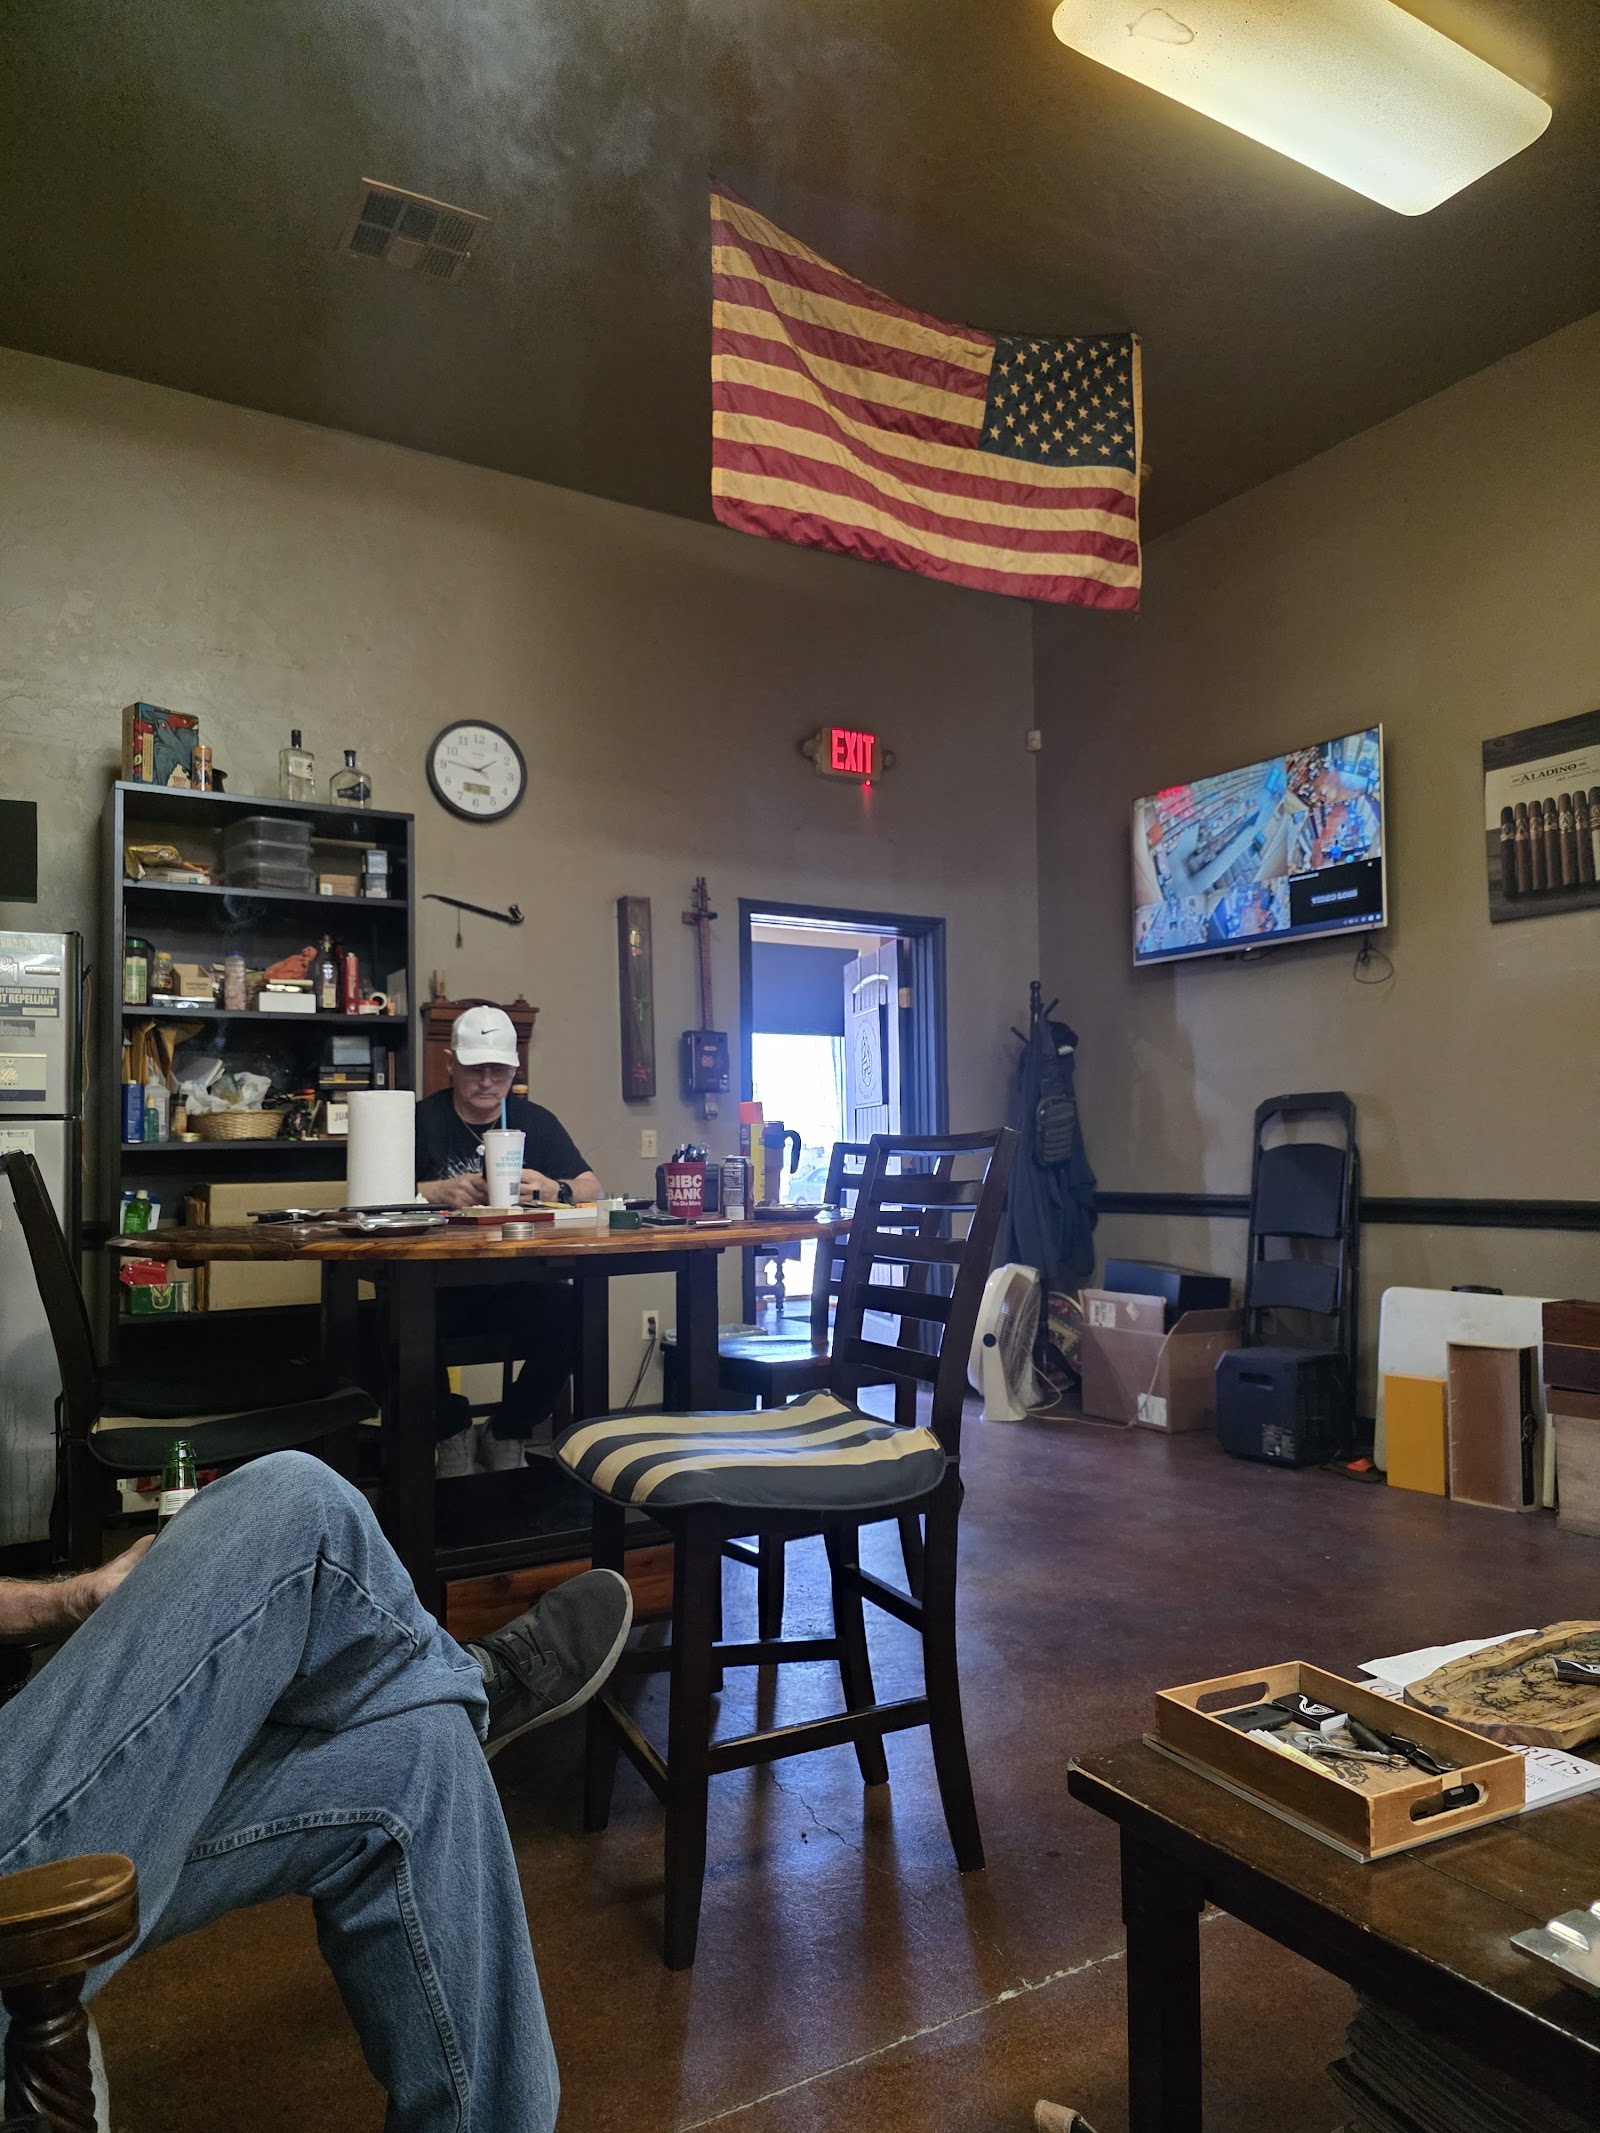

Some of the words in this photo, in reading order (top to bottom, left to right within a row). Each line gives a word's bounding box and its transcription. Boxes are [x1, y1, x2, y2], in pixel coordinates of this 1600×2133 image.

[459, 735, 468, 746] 11
[474, 734, 485, 745] 12
[447, 746, 458, 756] 10
[493, 742, 499, 752] 1
[831, 728, 875, 775] EXIT
[440, 760, 447, 769] 9
[504, 757, 511, 766] 2
[508, 773, 514, 782] 3
[1520, 763, 1577, 783] ALADINO
[445, 776, 451, 785] 8
[457, 792, 463, 800] 7
[502, 787, 508, 796] 4
[472, 799, 479, 808] 6
[490, 796, 496, 806] 5
[8, 994, 55, 1006] REPELLANT
[676, 1174, 703, 1188] IBC
[667, 1187, 702, 1201] BANK
